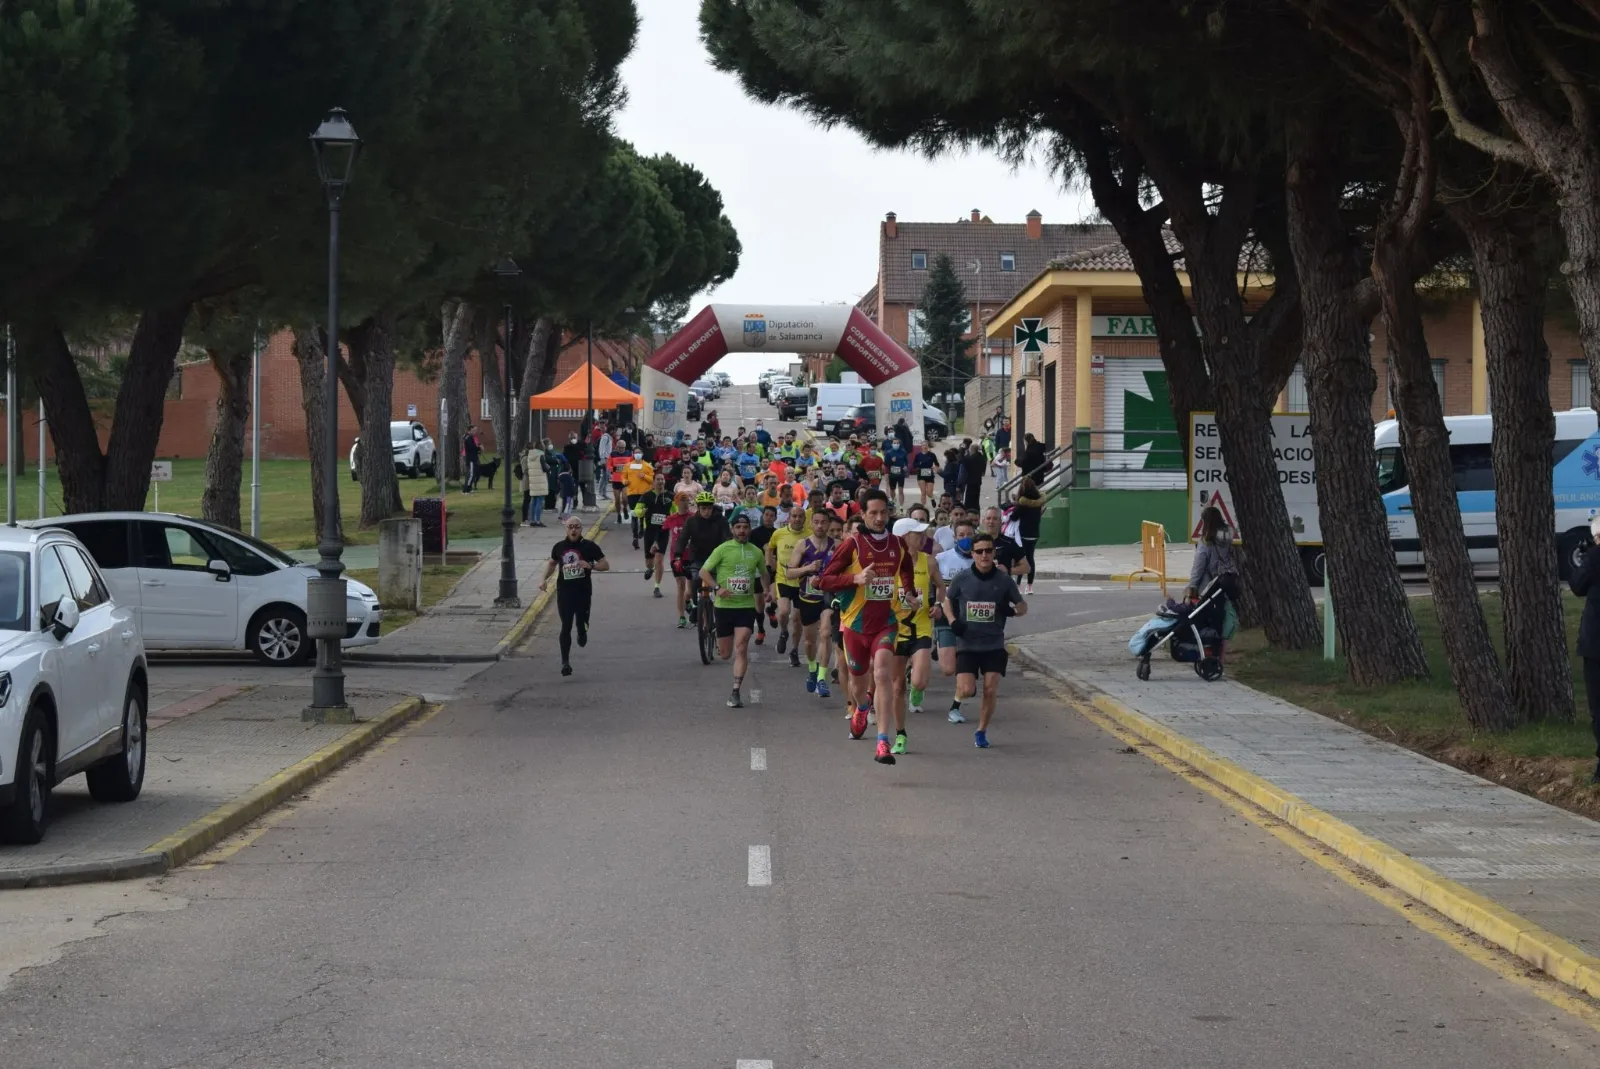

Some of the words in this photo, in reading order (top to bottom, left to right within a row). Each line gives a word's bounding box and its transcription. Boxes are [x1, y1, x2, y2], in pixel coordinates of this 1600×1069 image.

[769, 320, 814, 330] Diputación
[1107, 317, 1156, 334] FAR
[780, 332, 823, 341] Salamanca
[664, 359, 680, 374] CON
[679, 352, 689, 361] EL
[688, 324, 719, 353] DEPORTE
[850, 326, 866, 340] CON
[864, 340, 899, 371] NUESTROS
[846, 335, 890, 375] DEPORTISTAS
[645, 428, 676, 438] Diputació
[1274, 447, 1313, 461] ACIO
[731, 583, 747, 591] 748
[871, 585, 890, 595] 795
[972, 609, 990, 617] 788
